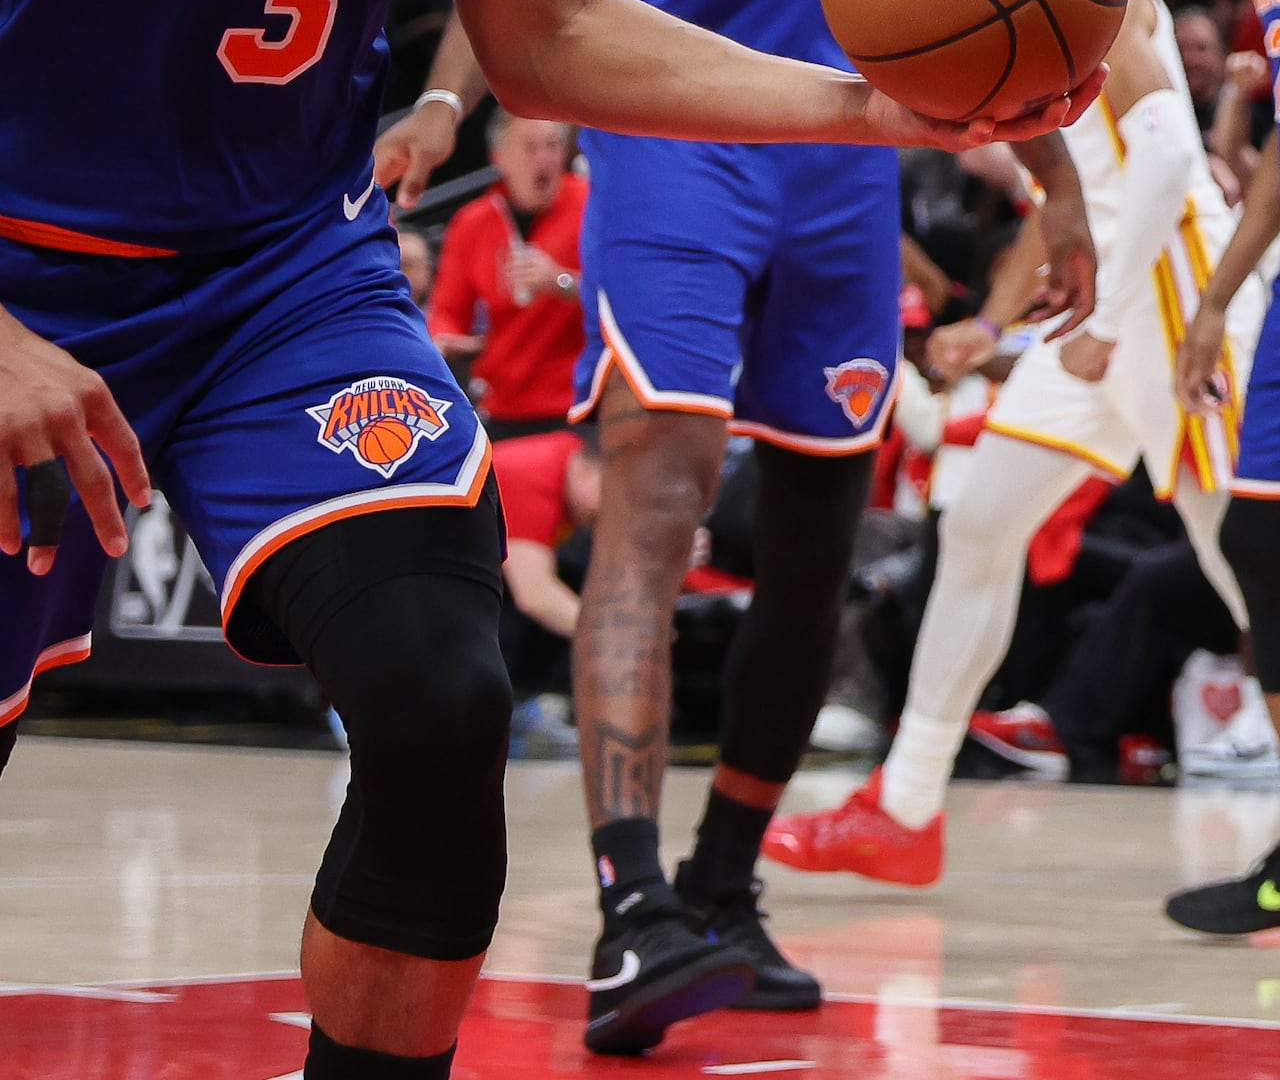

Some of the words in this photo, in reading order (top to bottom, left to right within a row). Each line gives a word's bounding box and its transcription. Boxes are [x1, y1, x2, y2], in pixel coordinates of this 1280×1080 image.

[354, 381, 377, 394] NEW
[378, 379, 405, 391] YORK
[323, 388, 444, 440] KNICKS
